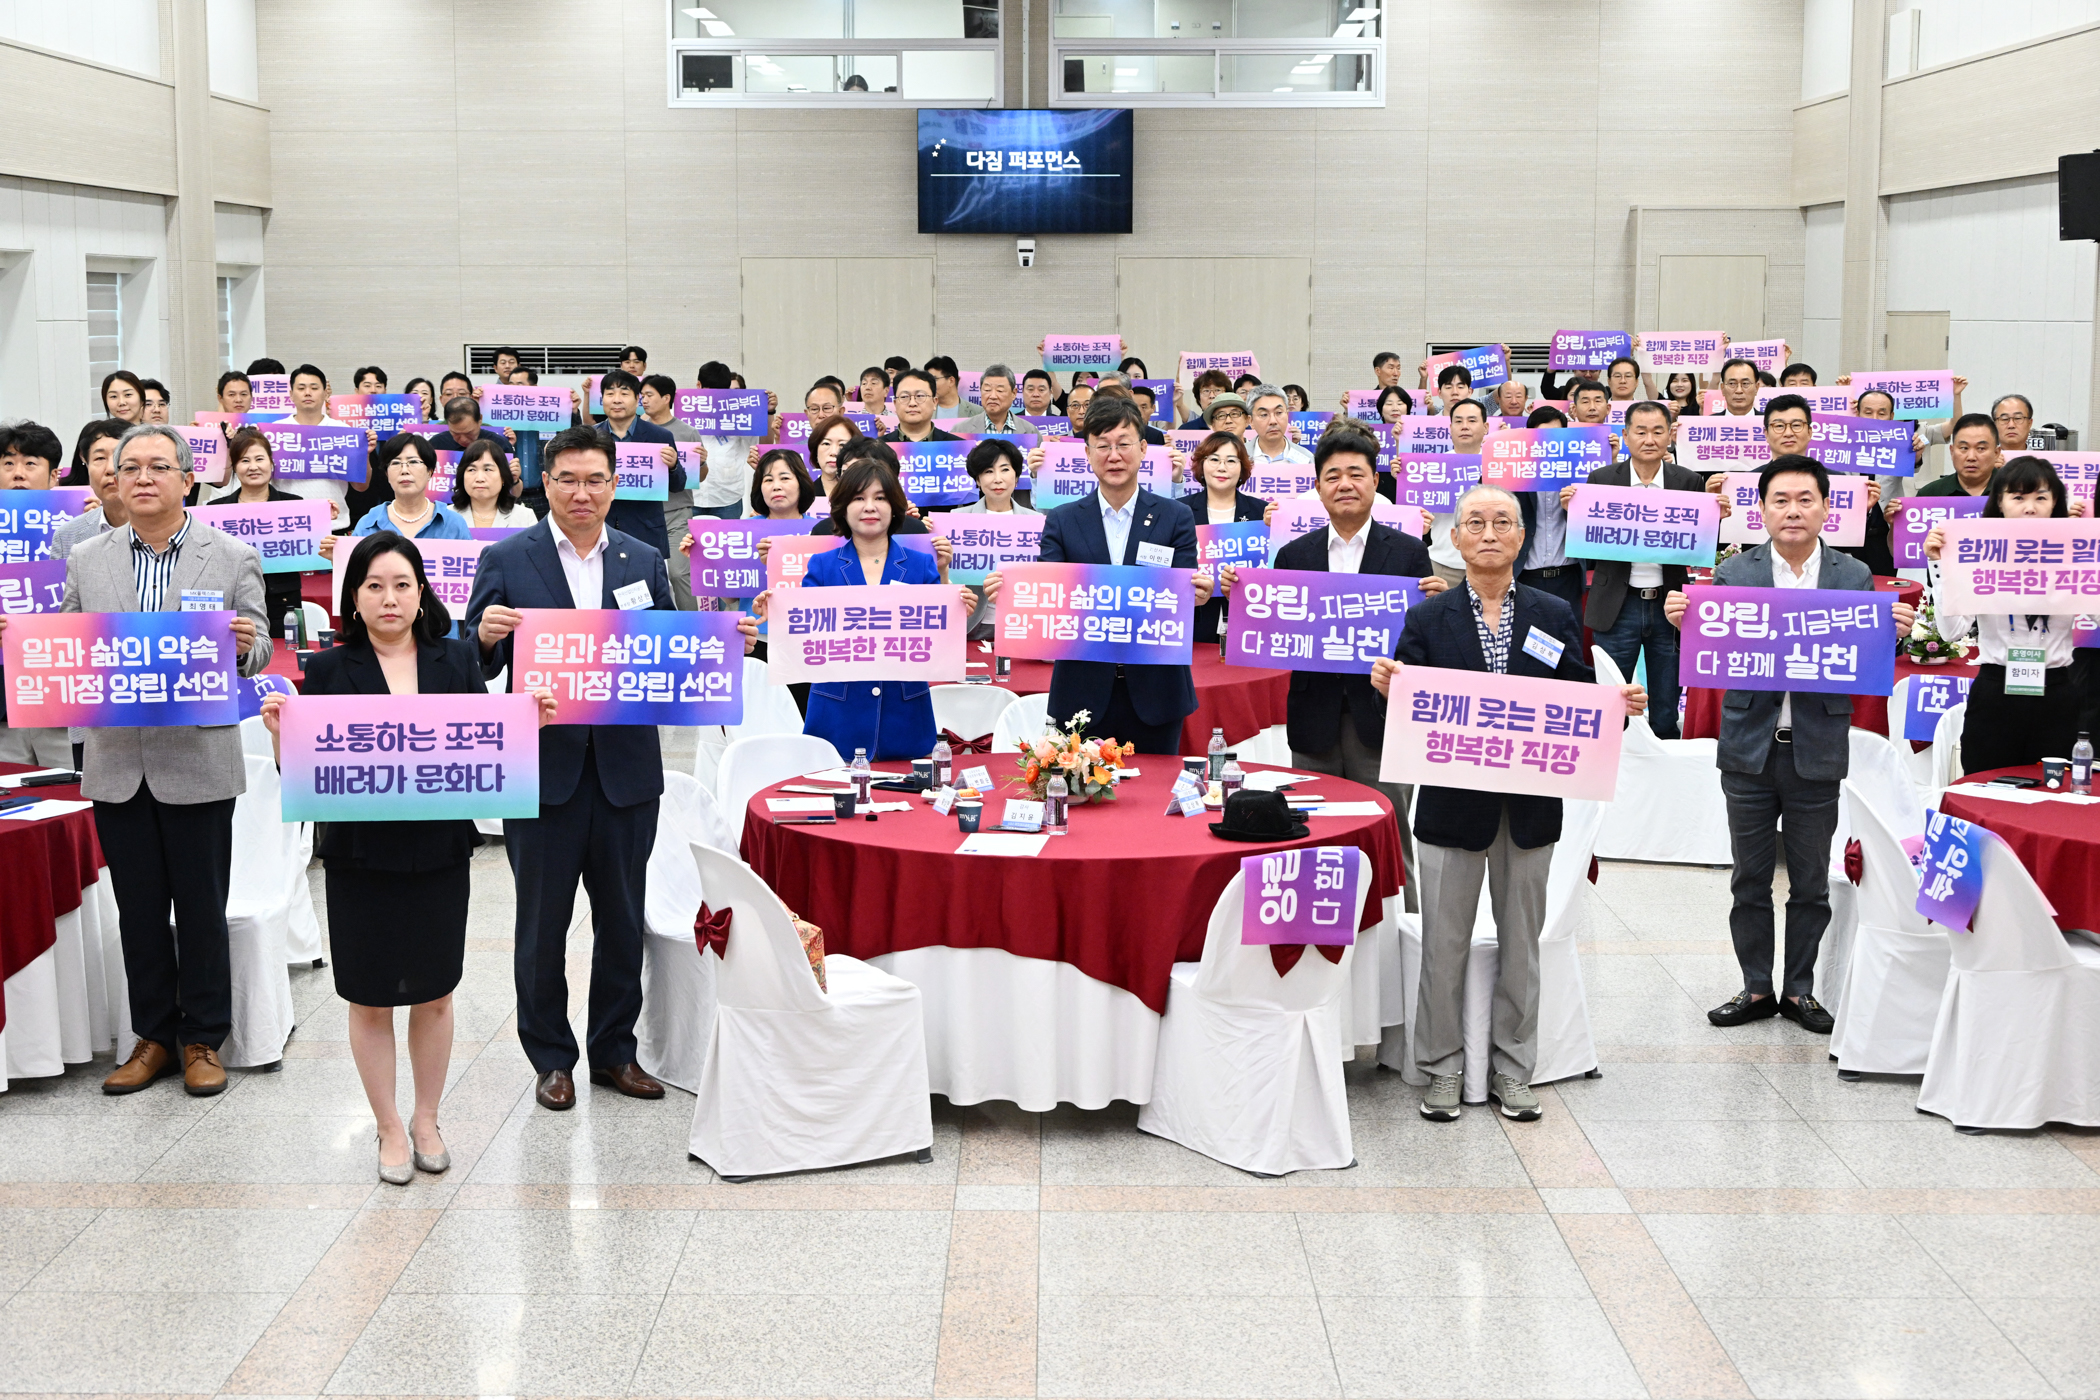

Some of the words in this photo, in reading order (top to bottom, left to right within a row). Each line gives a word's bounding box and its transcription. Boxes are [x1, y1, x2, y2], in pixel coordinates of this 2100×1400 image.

[966, 151, 1003, 171] 다짐
[1008, 151, 1081, 171] 퍼포먼스
[1053, 342, 1090, 351] 소통하는
[1092, 342, 1111, 351] 조직
[1556, 335, 1587, 350] 양립,
[1588, 336, 1625, 349] 지금부터
[1646, 340, 1667, 352] 함께
[1671, 340, 1691, 351] 웃는
[1694, 339, 1716, 351] 일터
[1735, 347, 1755, 358] 웃는
[1757, 345, 1778, 357] 일터
[1052, 354, 1081, 364] 배려가
[1083, 355, 1111, 365] 문화다
[1186, 358, 1206, 369] 함께
[1209, 357, 1229, 368] 웃는
[1232, 356, 1252, 367] 일터
[1478, 353, 1499, 365] 약속
[1555, 356, 1565, 364] 다
[1567, 355, 1586, 364] 함께
[1588, 351, 1617, 365] 실천
[1653, 353, 1685, 365] 행복한
[1687, 353, 1709, 365] 직장
[1485, 365, 1504, 378] 선언
[263, 380, 288, 393] 웃는
[1915, 380, 1940, 392] 조직
[338, 403, 363, 417] 일과
[364, 403, 388, 416] 삶의
[391, 403, 415, 415] 약속
[491, 394, 536, 407] 소통하는
[538, 395, 561, 408] 조직
[681, 395, 717, 413] 양립,
[717, 395, 761, 410] 지금부터
[1820, 397, 1848, 411] 일터
[1903, 397, 1940, 409] 문화다
[371, 418, 394, 431] 양립
[491, 410, 525, 421] 배려가
[527, 410, 560, 422] 문화다
[694, 417, 716, 430] 함께
[719, 414, 752, 430] 실천
[263, 431, 306, 453] 양립,
[308, 434, 359, 450] 지금부터
[1688, 426, 1716, 442] 함께
[1721, 427, 1748, 442] 웃는
[1810, 422, 1852, 444] 양립,
[1854, 427, 1908, 443] 지금부터
[189, 437, 217, 454] 일터
[1493, 440, 1527, 458] 일과
[1530, 441, 1564, 458] 삶의
[1568, 440, 1602, 457] 약속
[1697, 445, 1739, 461] 행복한
[279, 458, 305, 473] 함께
[309, 454, 348, 474] 실천
[626, 455, 653, 469] 조직
[899, 456, 931, 472] 삶의
[1824, 449, 1851, 465] 함께
[1855, 445, 1897, 469] 실천
[1406, 461, 1451, 484] 양립,
[1540, 461, 1572, 478] 양립
[907, 476, 940, 493] 양립
[943, 475, 973, 493] 선언
[1260, 477, 1291, 493] 웃는
[1406, 490, 1419, 504] 다
[1422, 490, 1450, 506] 함께
[1587, 501, 1659, 522] 소통하는
[1663, 506, 1699, 526] 조직
[278, 515, 311, 533] 조직
[700, 531, 759, 561] 양립,
[946, 529, 1012, 547] 소통하는
[1585, 525, 1640, 546] 배려가
[1643, 529, 1697, 550] 문화다
[262, 538, 313, 557] 문화다
[1205, 537, 1242, 559] 삶의
[1905, 542, 1922, 560] 다
[1958, 538, 2008, 563] 함께
[2014, 539, 2065, 563] 웃는
[702, 569, 719, 588] 다
[723, 568, 759, 588] 함께
[1972, 568, 2048, 595] 행복한
[1013, 581, 1067, 610] 일과
[1070, 582, 1122, 612] 삶의
[1127, 584, 1178, 614] 약속
[1244, 583, 1315, 622] 양립,
[1320, 590, 1409, 619] 지금부터
[788, 606, 837, 636] 함께
[843, 605, 893, 632] 웃는
[899, 604, 948, 631] 일터
[1699, 600, 1778, 640] 양립,
[1782, 604, 1879, 637] 지금부터
[1004, 613, 1079, 641] 일·가정
[1083, 615, 1132, 645] 양립
[1136, 616, 1185, 647] 선언
[22, 637, 85, 668] 일과
[90, 636, 150, 667] 삶의
[158, 635, 218, 665] 약속
[534, 633, 597, 664] 일과
[602, 633, 660, 664] 삶의
[669, 634, 725, 665] 약속
[802, 636, 877, 666] 행복한
[883, 637, 933, 663] 직장
[1241, 631, 1264, 655] 다
[1270, 632, 1313, 659] 함께
[1321, 626, 1390, 662] 실천
[1696, 651, 1720, 675] 다
[1727, 651, 1774, 678] 함께
[1784, 643, 1858, 681] 실천
[16, 674, 104, 705] 일·가정
[109, 673, 168, 704] 양립
[173, 670, 229, 702] 선언
[618, 671, 674, 702] 양립
[680, 671, 733, 701] 선언
[1412, 690, 1469, 727] 함께
[1478, 697, 1537, 733] 웃는
[1544, 703, 1603, 739] 일터
[314, 721, 437, 753] 소통하는
[445, 721, 504, 752] 조직
[1425, 731, 1514, 769] 행복한
[1520, 744, 1580, 775] 직장
[314, 764, 408, 795] 배려가
[414, 762, 506, 794] 문화다
[1924, 843, 1969, 902] 약속
[1312, 897, 1342, 925] 다
